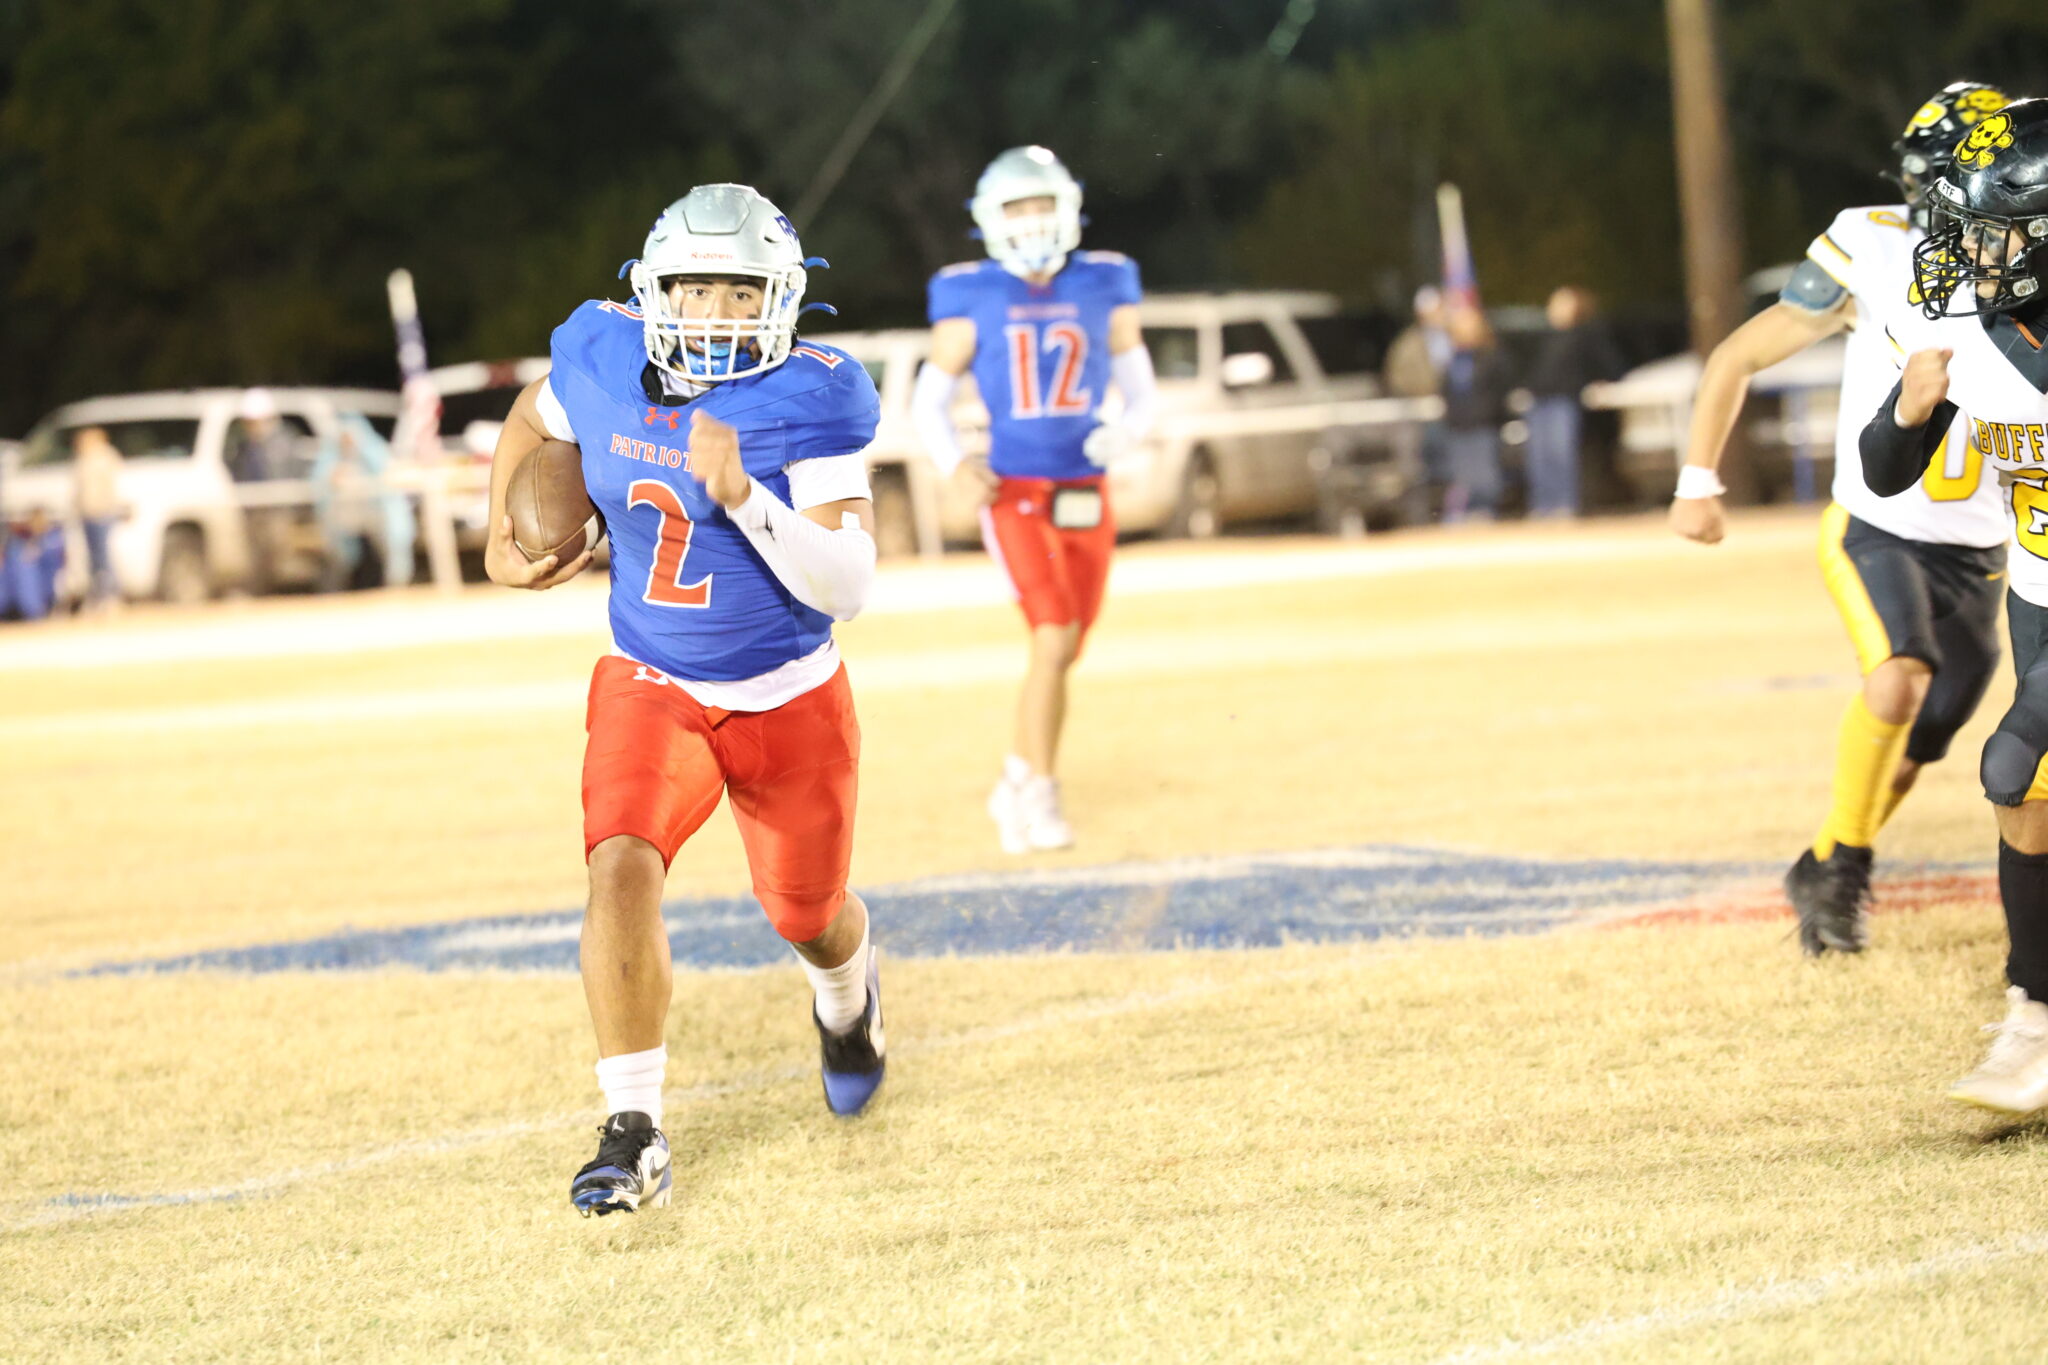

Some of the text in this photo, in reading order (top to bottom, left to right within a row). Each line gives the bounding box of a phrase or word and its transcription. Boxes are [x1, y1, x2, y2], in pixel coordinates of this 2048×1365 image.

[1003, 321, 1091, 420] 12
[1973, 416, 2048, 463] BUFF
[626, 478, 714, 609] 2
